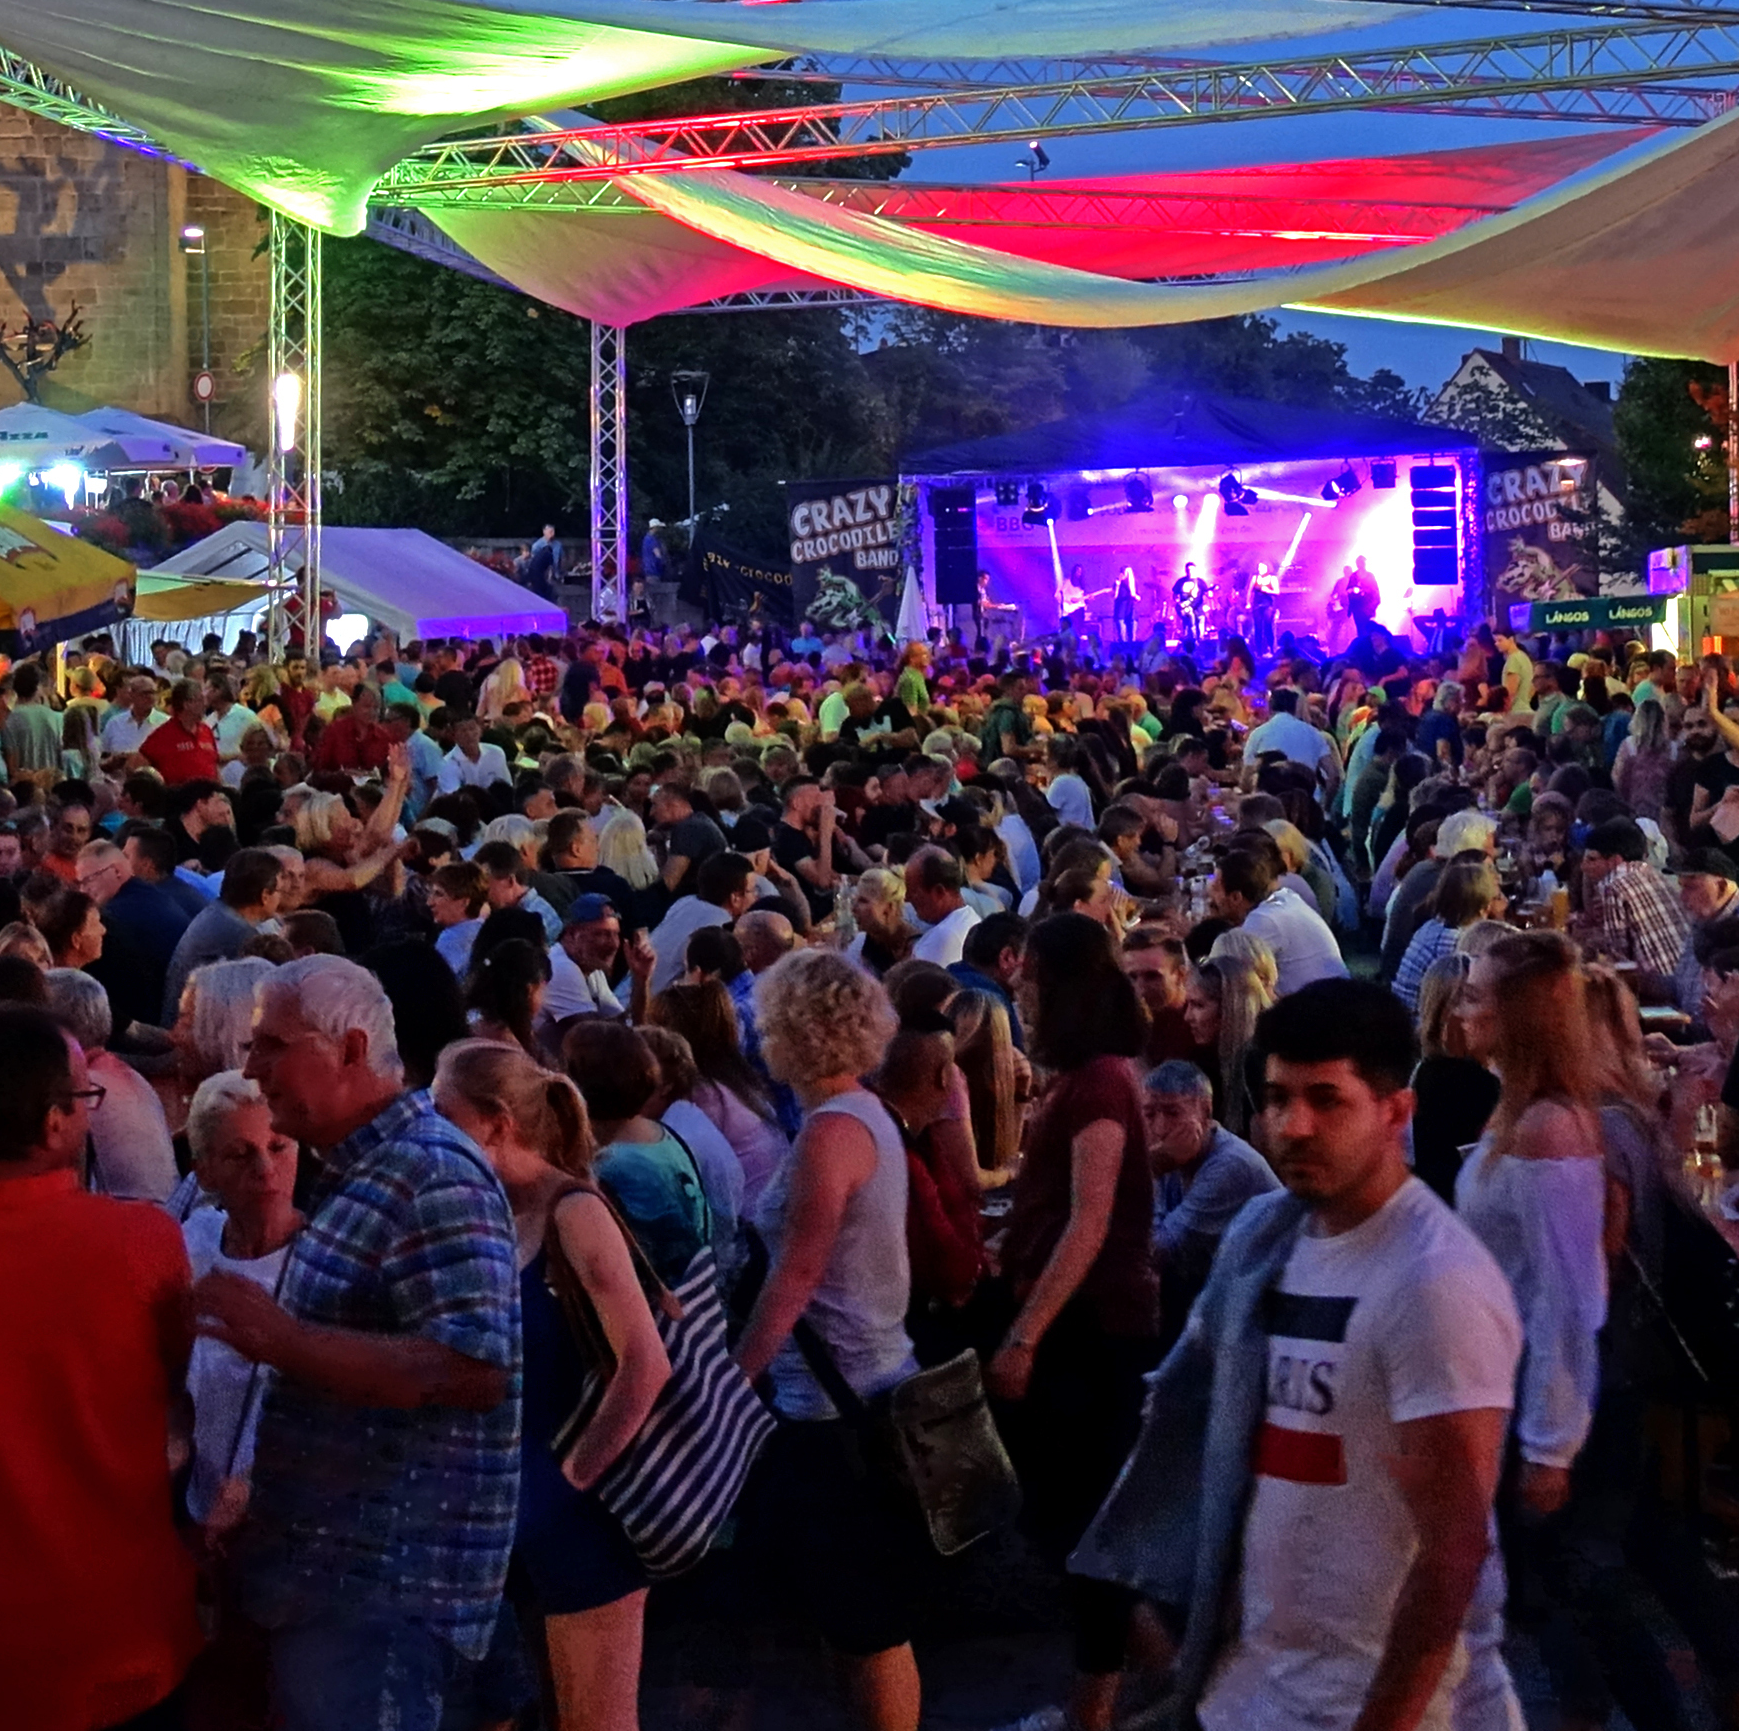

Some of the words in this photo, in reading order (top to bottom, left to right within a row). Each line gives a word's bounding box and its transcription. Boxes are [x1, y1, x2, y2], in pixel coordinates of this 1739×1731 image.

[792, 485, 890, 536] CRAZY
[792, 520, 899, 562] CROCODILE
[856, 550, 899, 568] BAND
[1545, 610, 1590, 624] LÁNGOS
[1609, 605, 1653, 620] LÁNGOS
